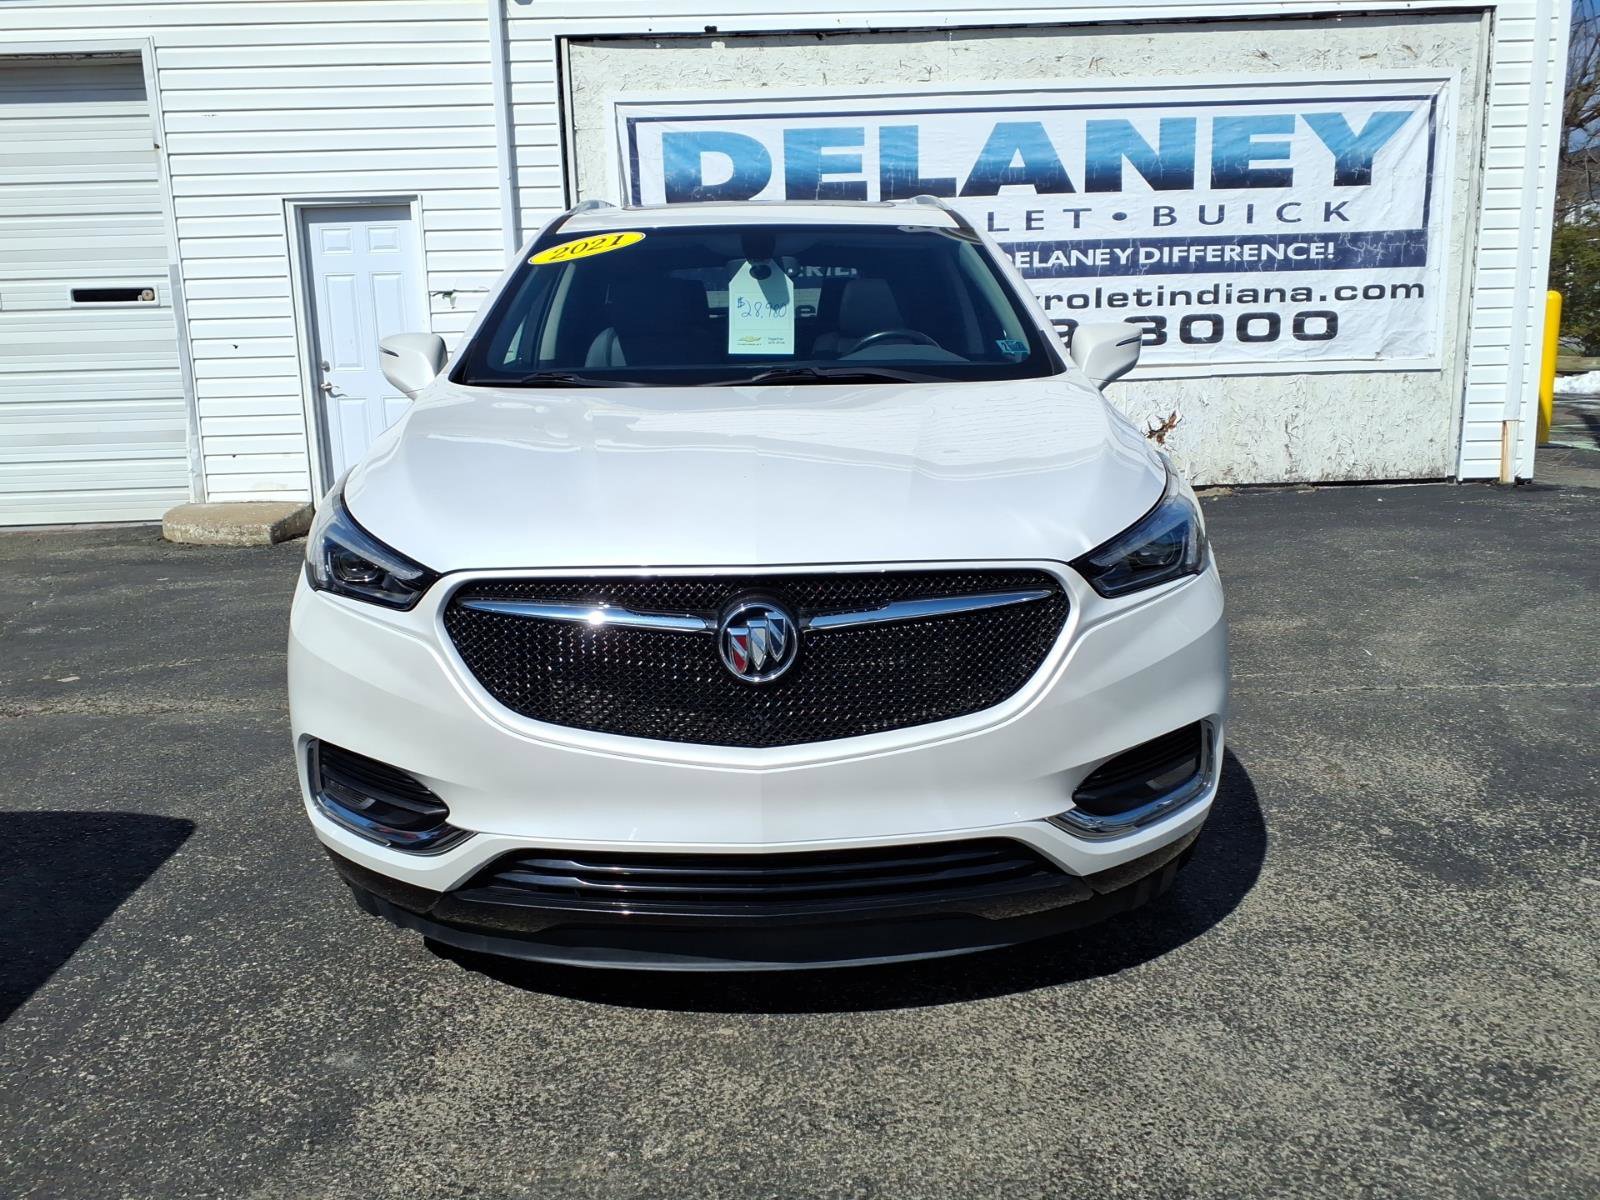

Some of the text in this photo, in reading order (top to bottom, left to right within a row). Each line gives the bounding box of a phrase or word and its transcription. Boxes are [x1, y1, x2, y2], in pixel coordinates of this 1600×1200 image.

[662, 110, 1414, 203] DELANEY
[1153, 200, 1350, 227] BUICK
[549, 234, 625, 260] 2021
[1139, 241, 1335, 265] DIFFERENCE!
[1036, 282, 1425, 311] roletindiana.com
